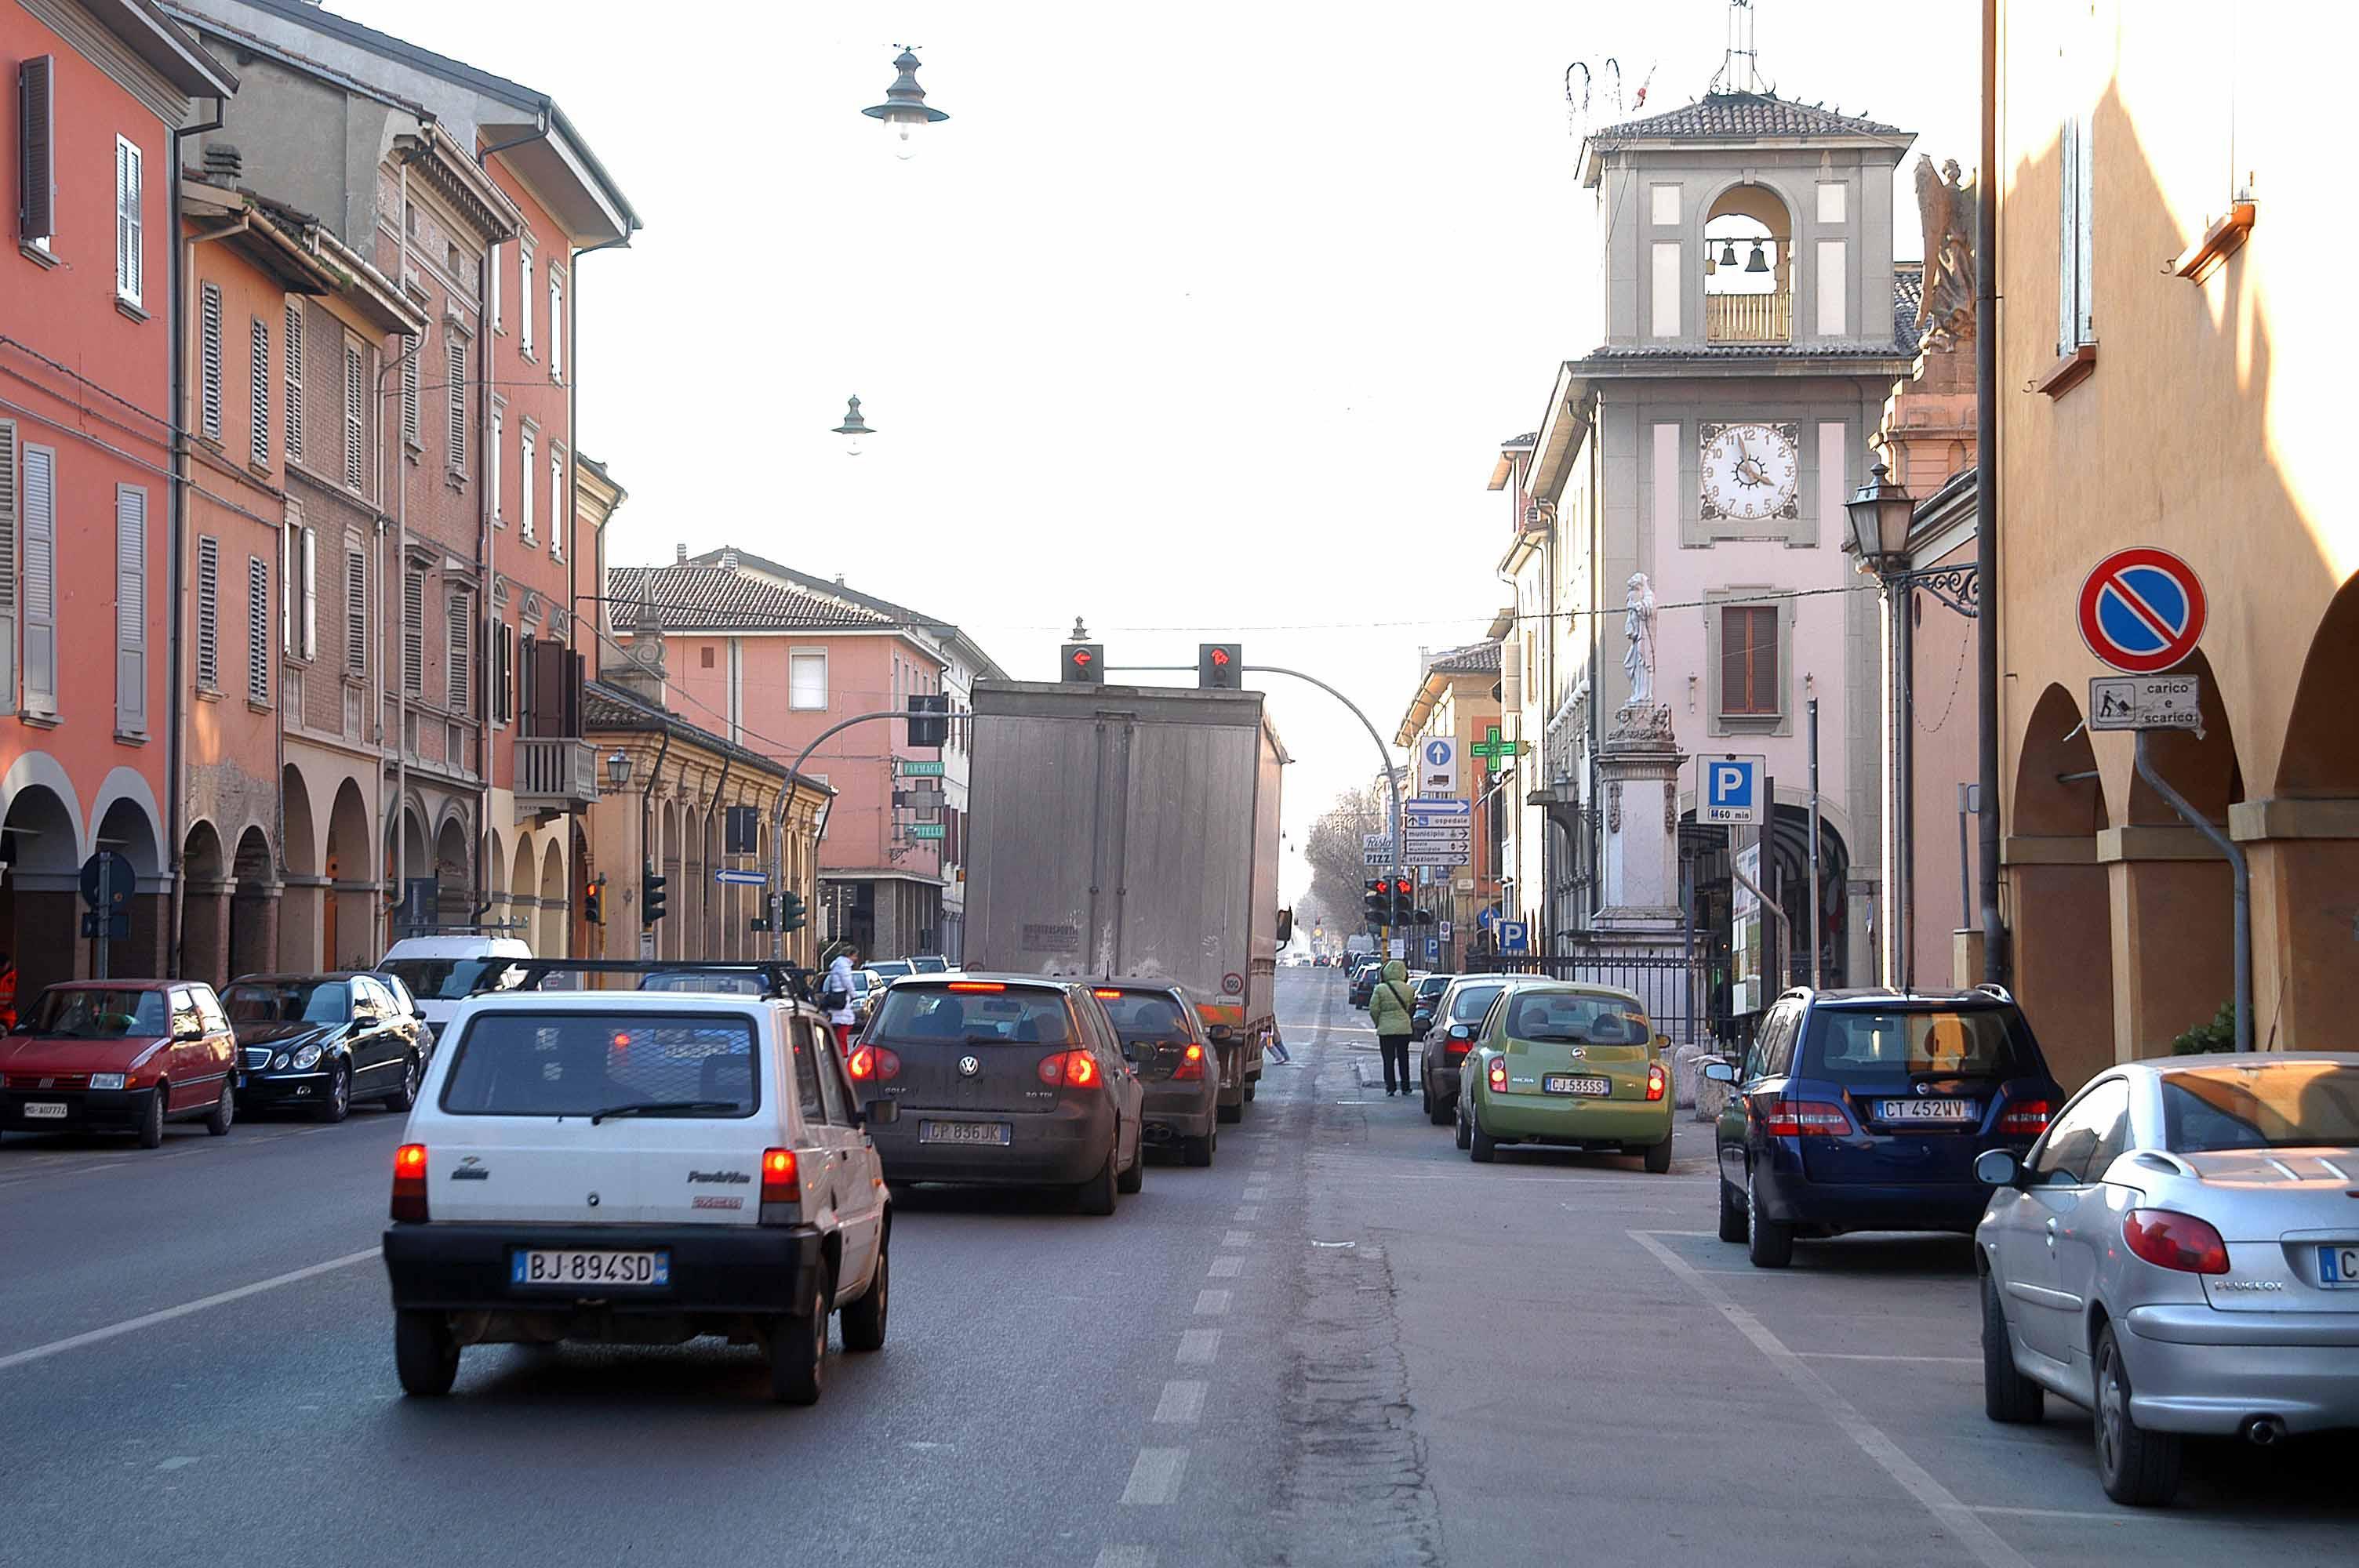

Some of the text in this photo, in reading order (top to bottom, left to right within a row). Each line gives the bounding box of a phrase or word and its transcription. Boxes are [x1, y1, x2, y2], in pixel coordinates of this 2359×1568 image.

[1725, 434, 1735, 445] 11
[1743, 430, 1756, 441] 12
[1765, 434, 1769, 445] 1
[1712, 448, 1722, 459] 10
[1778, 447, 1787, 458] 2
[1707, 466, 1713, 477] 9
[1785, 466, 1791, 477] 3
[1712, 485, 1719, 496] 8
[1777, 485, 1785, 495] 4
[1728, 499, 1736, 510] 7
[1746, 503, 1753, 514] 6
[1764, 499, 1771, 510] 5
[2147, 683, 2188, 693] carico
[2165, 699, 2172, 708] e
[2145, 712, 2193, 723] scarico
[904, 764, 942, 773] FARMACIA
[1717, 767, 1743, 801] P
[1718, 810, 1749, 818] 60 min
[1408, 829, 1445, 838] municipio
[1366, 855, 1393, 864] PIZZ
[1504, 924, 1522, 947] P
[1428, 939, 1438, 955] P
[1552, 1078, 1566, 1091] CJ
[1569, 1080, 1602, 1092] 533SS
[1885, 1102, 1905, 1117] CT
[1912, 1101, 1961, 1116] 452WV
[531, 1254, 562, 1280] BJ
[572, 1254, 651, 1281] 894SD
[2214, 1280, 2284, 1291] PEUGEOT
